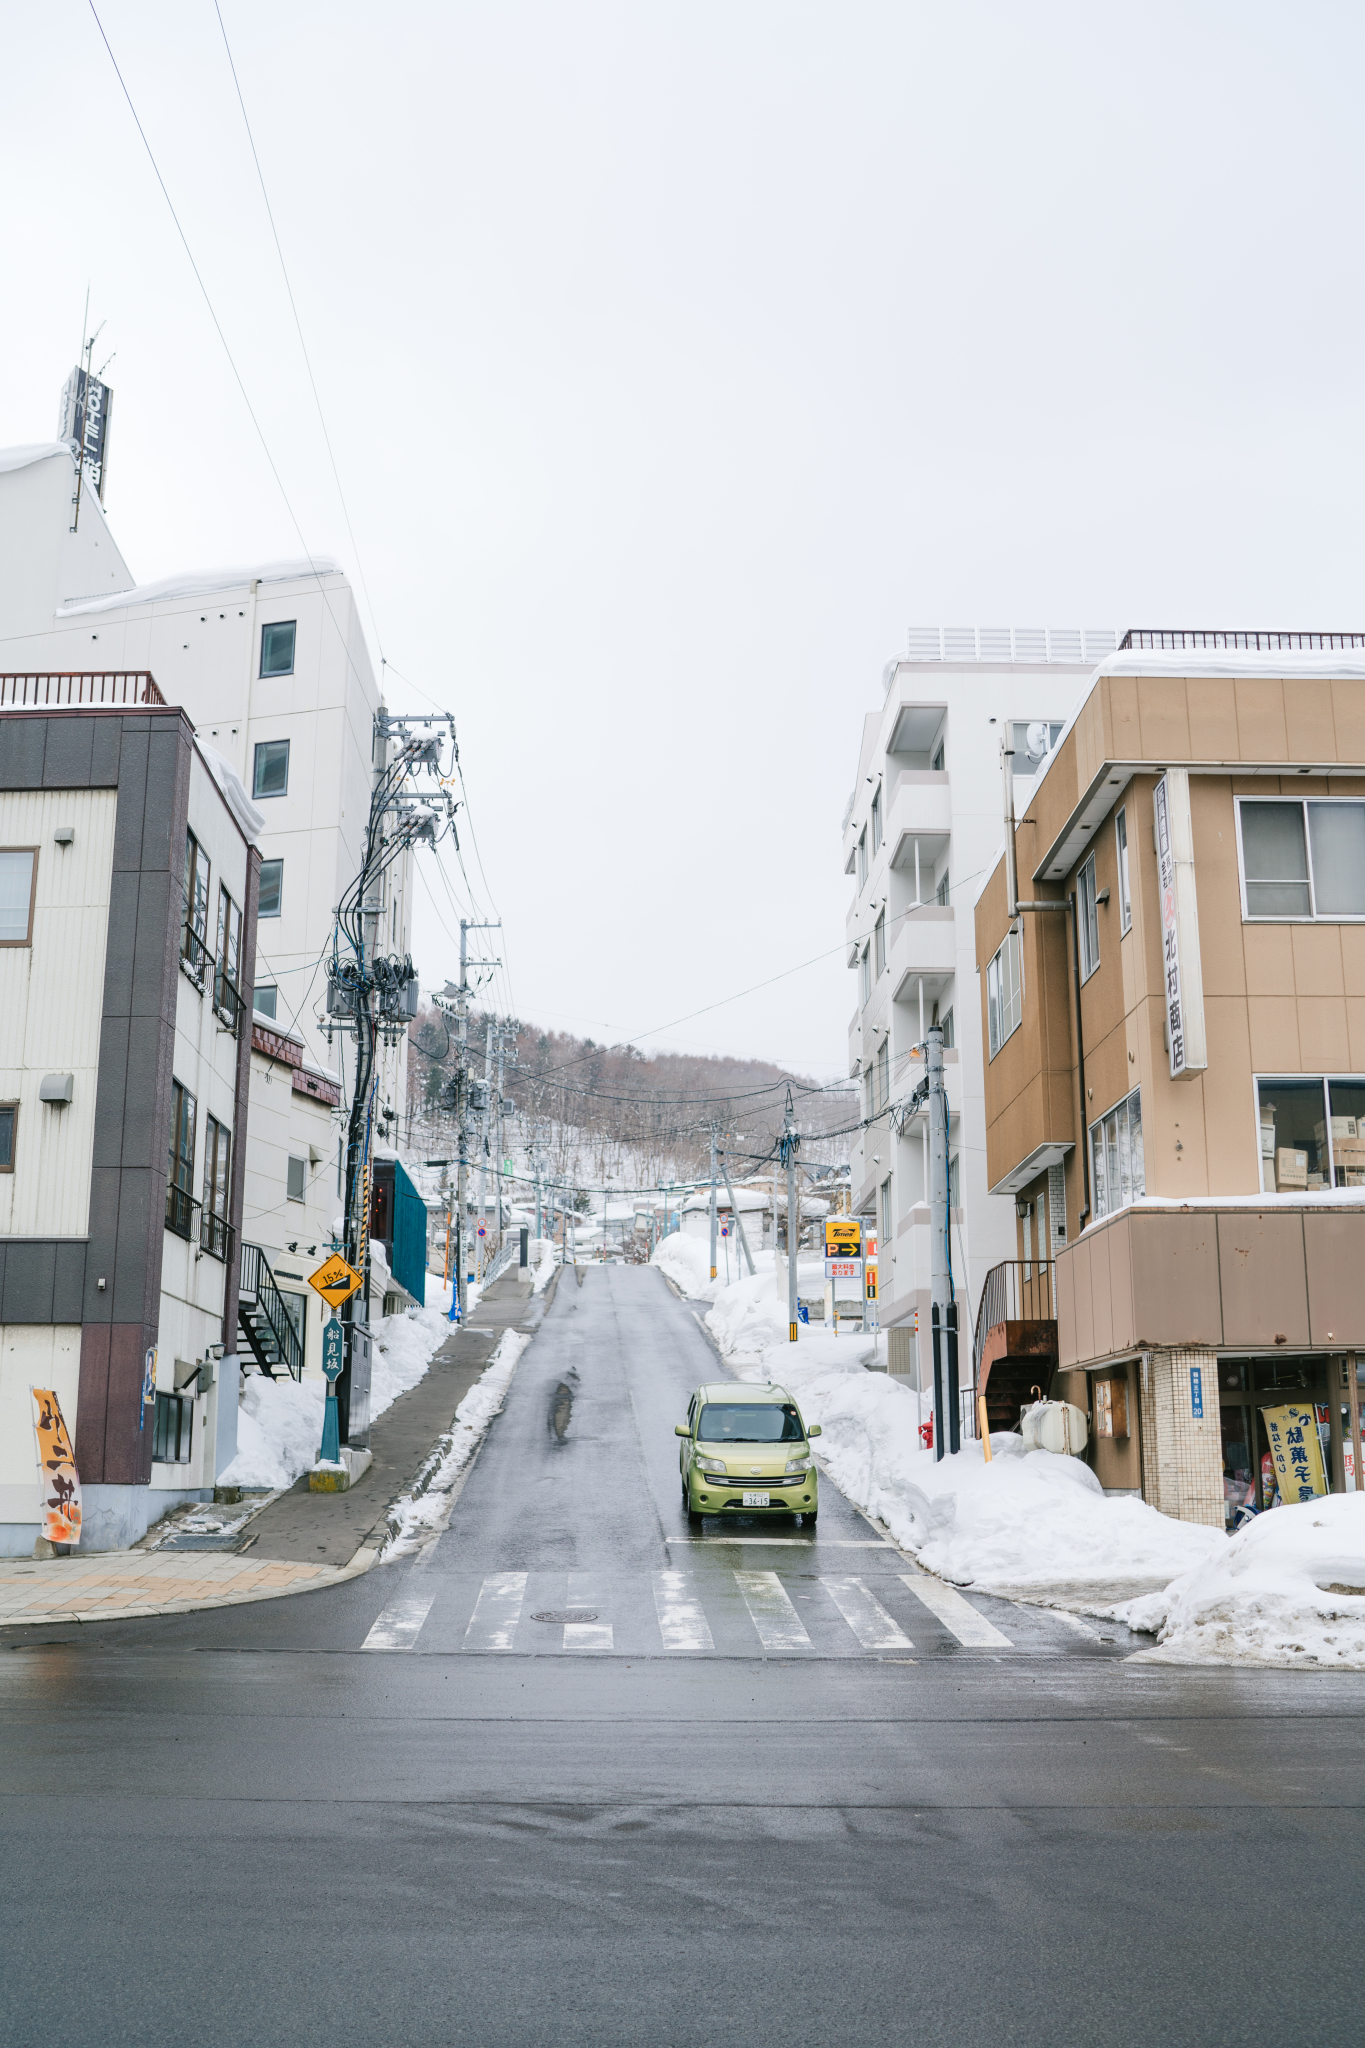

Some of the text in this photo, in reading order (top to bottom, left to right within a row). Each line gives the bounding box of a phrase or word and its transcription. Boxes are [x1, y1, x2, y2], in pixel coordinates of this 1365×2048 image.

[1165, 928, 1184, 1070] 北村商店
[828, 1244, 838, 1256] P
[323, 1269, 343, 1285] 15%
[326, 1327, 340, 1370] 船見坂
[1193, 1407, 1202, 1415] 20
